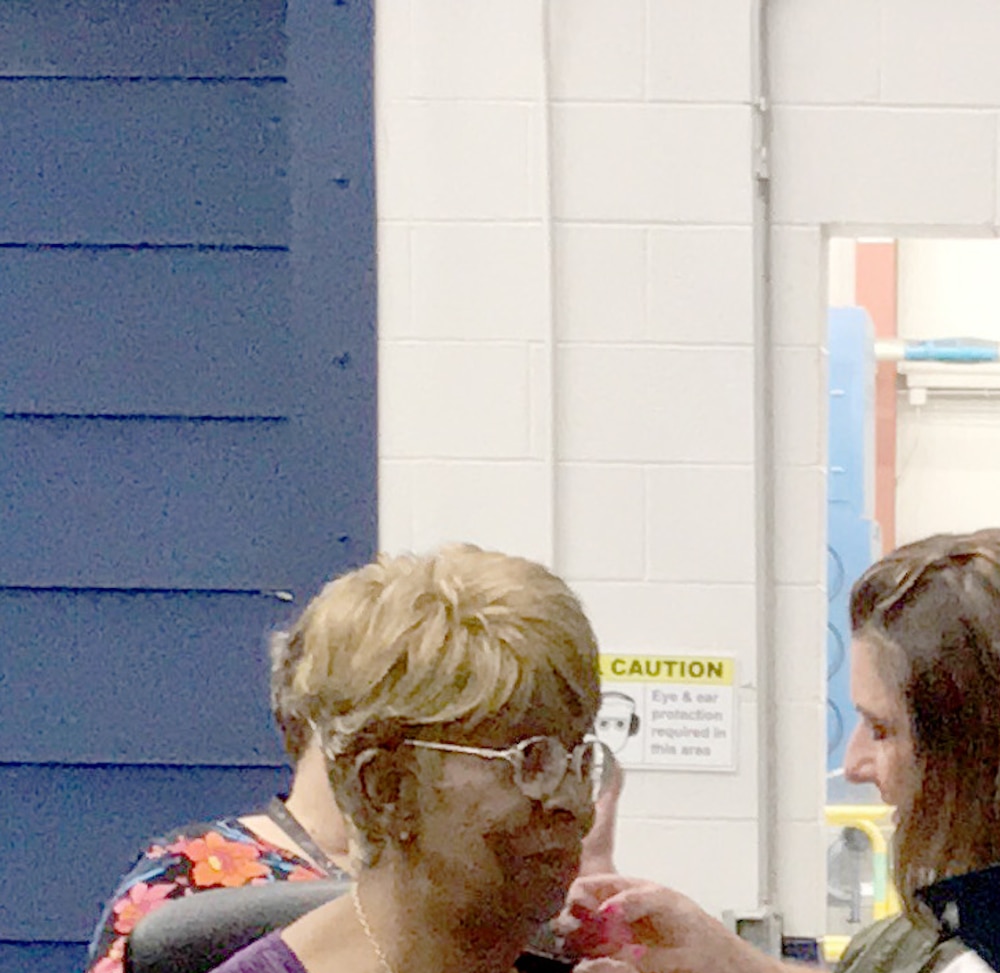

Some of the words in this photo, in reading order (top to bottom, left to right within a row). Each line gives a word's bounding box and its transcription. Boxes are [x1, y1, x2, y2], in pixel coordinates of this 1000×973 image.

[611, 659, 723, 678] CAUTION
[651, 689, 678, 704] Eye
[682, 690, 692, 703] &
[695, 692, 719, 703] ear
[651, 709, 723, 722] protection
[651, 726, 710, 739] required
[714, 727, 727, 738] in
[650, 743, 677, 755] this
[681, 746, 711, 756] area
